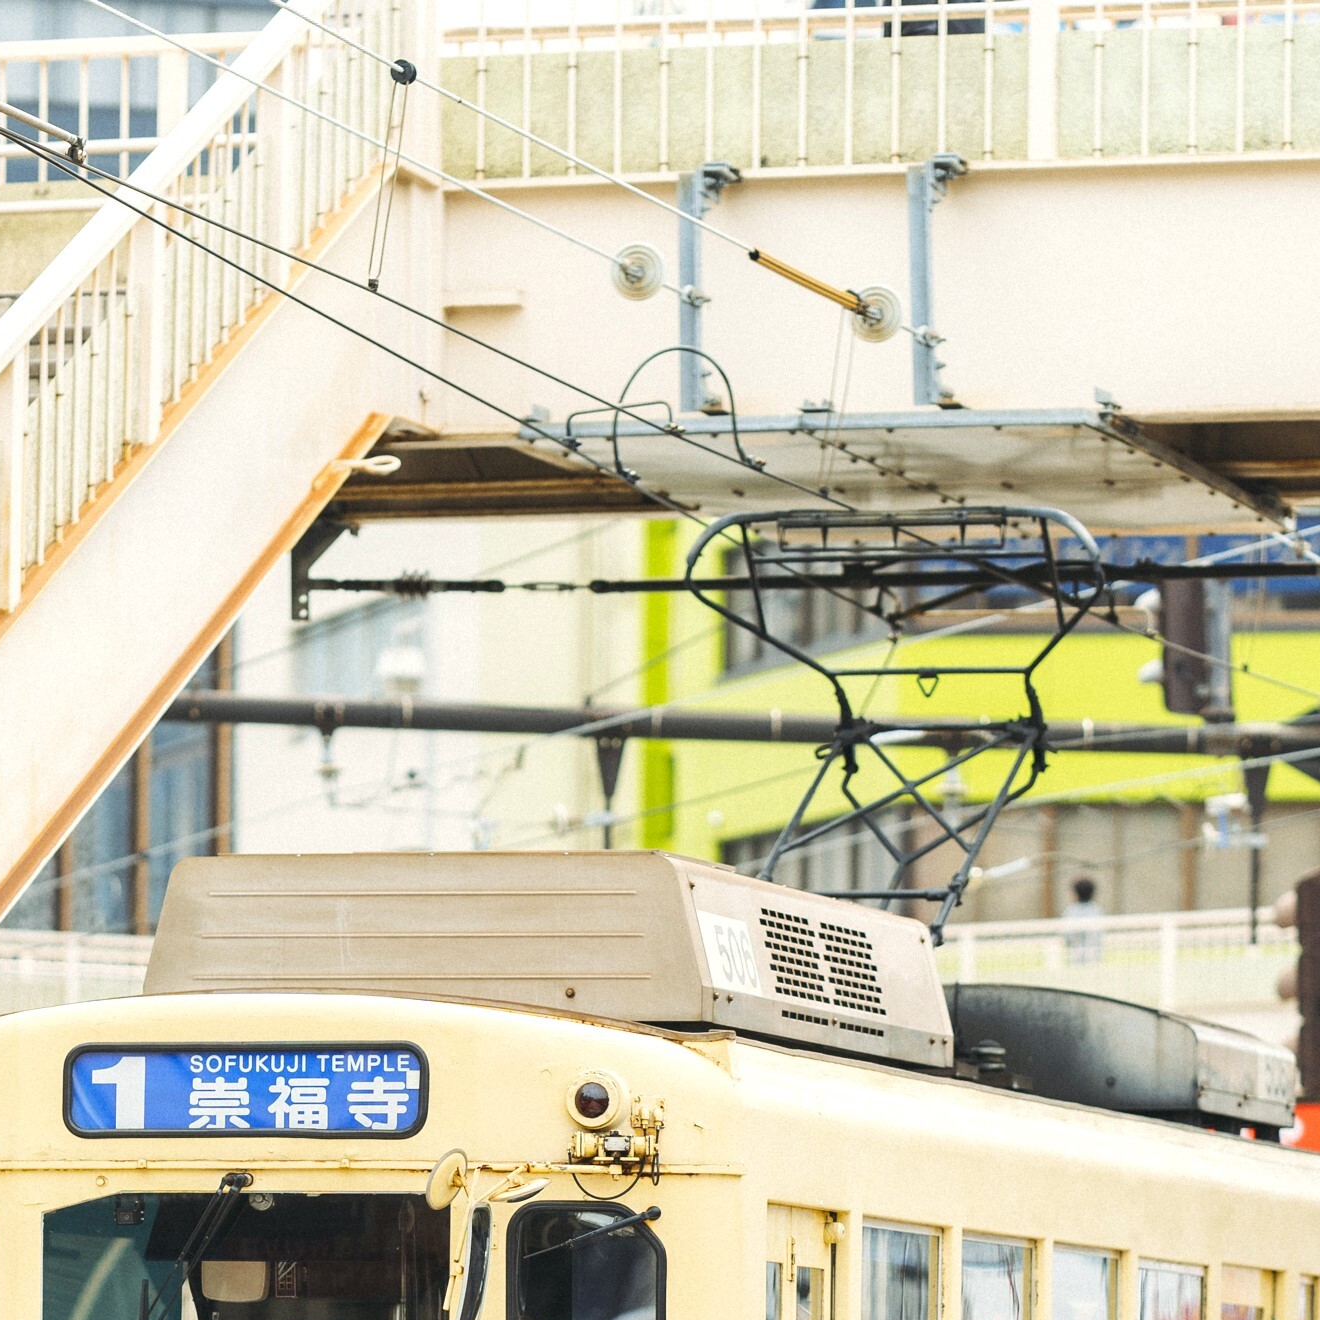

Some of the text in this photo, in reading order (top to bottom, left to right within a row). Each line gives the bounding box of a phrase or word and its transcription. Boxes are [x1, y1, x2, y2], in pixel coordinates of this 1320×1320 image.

[714, 924, 758, 989] 506
[91, 1056, 146, 1129] 1
[189, 1055, 411, 1073] SOFUKUJI TEMPLE
[188, 1076, 410, 1130] 崇福寺
